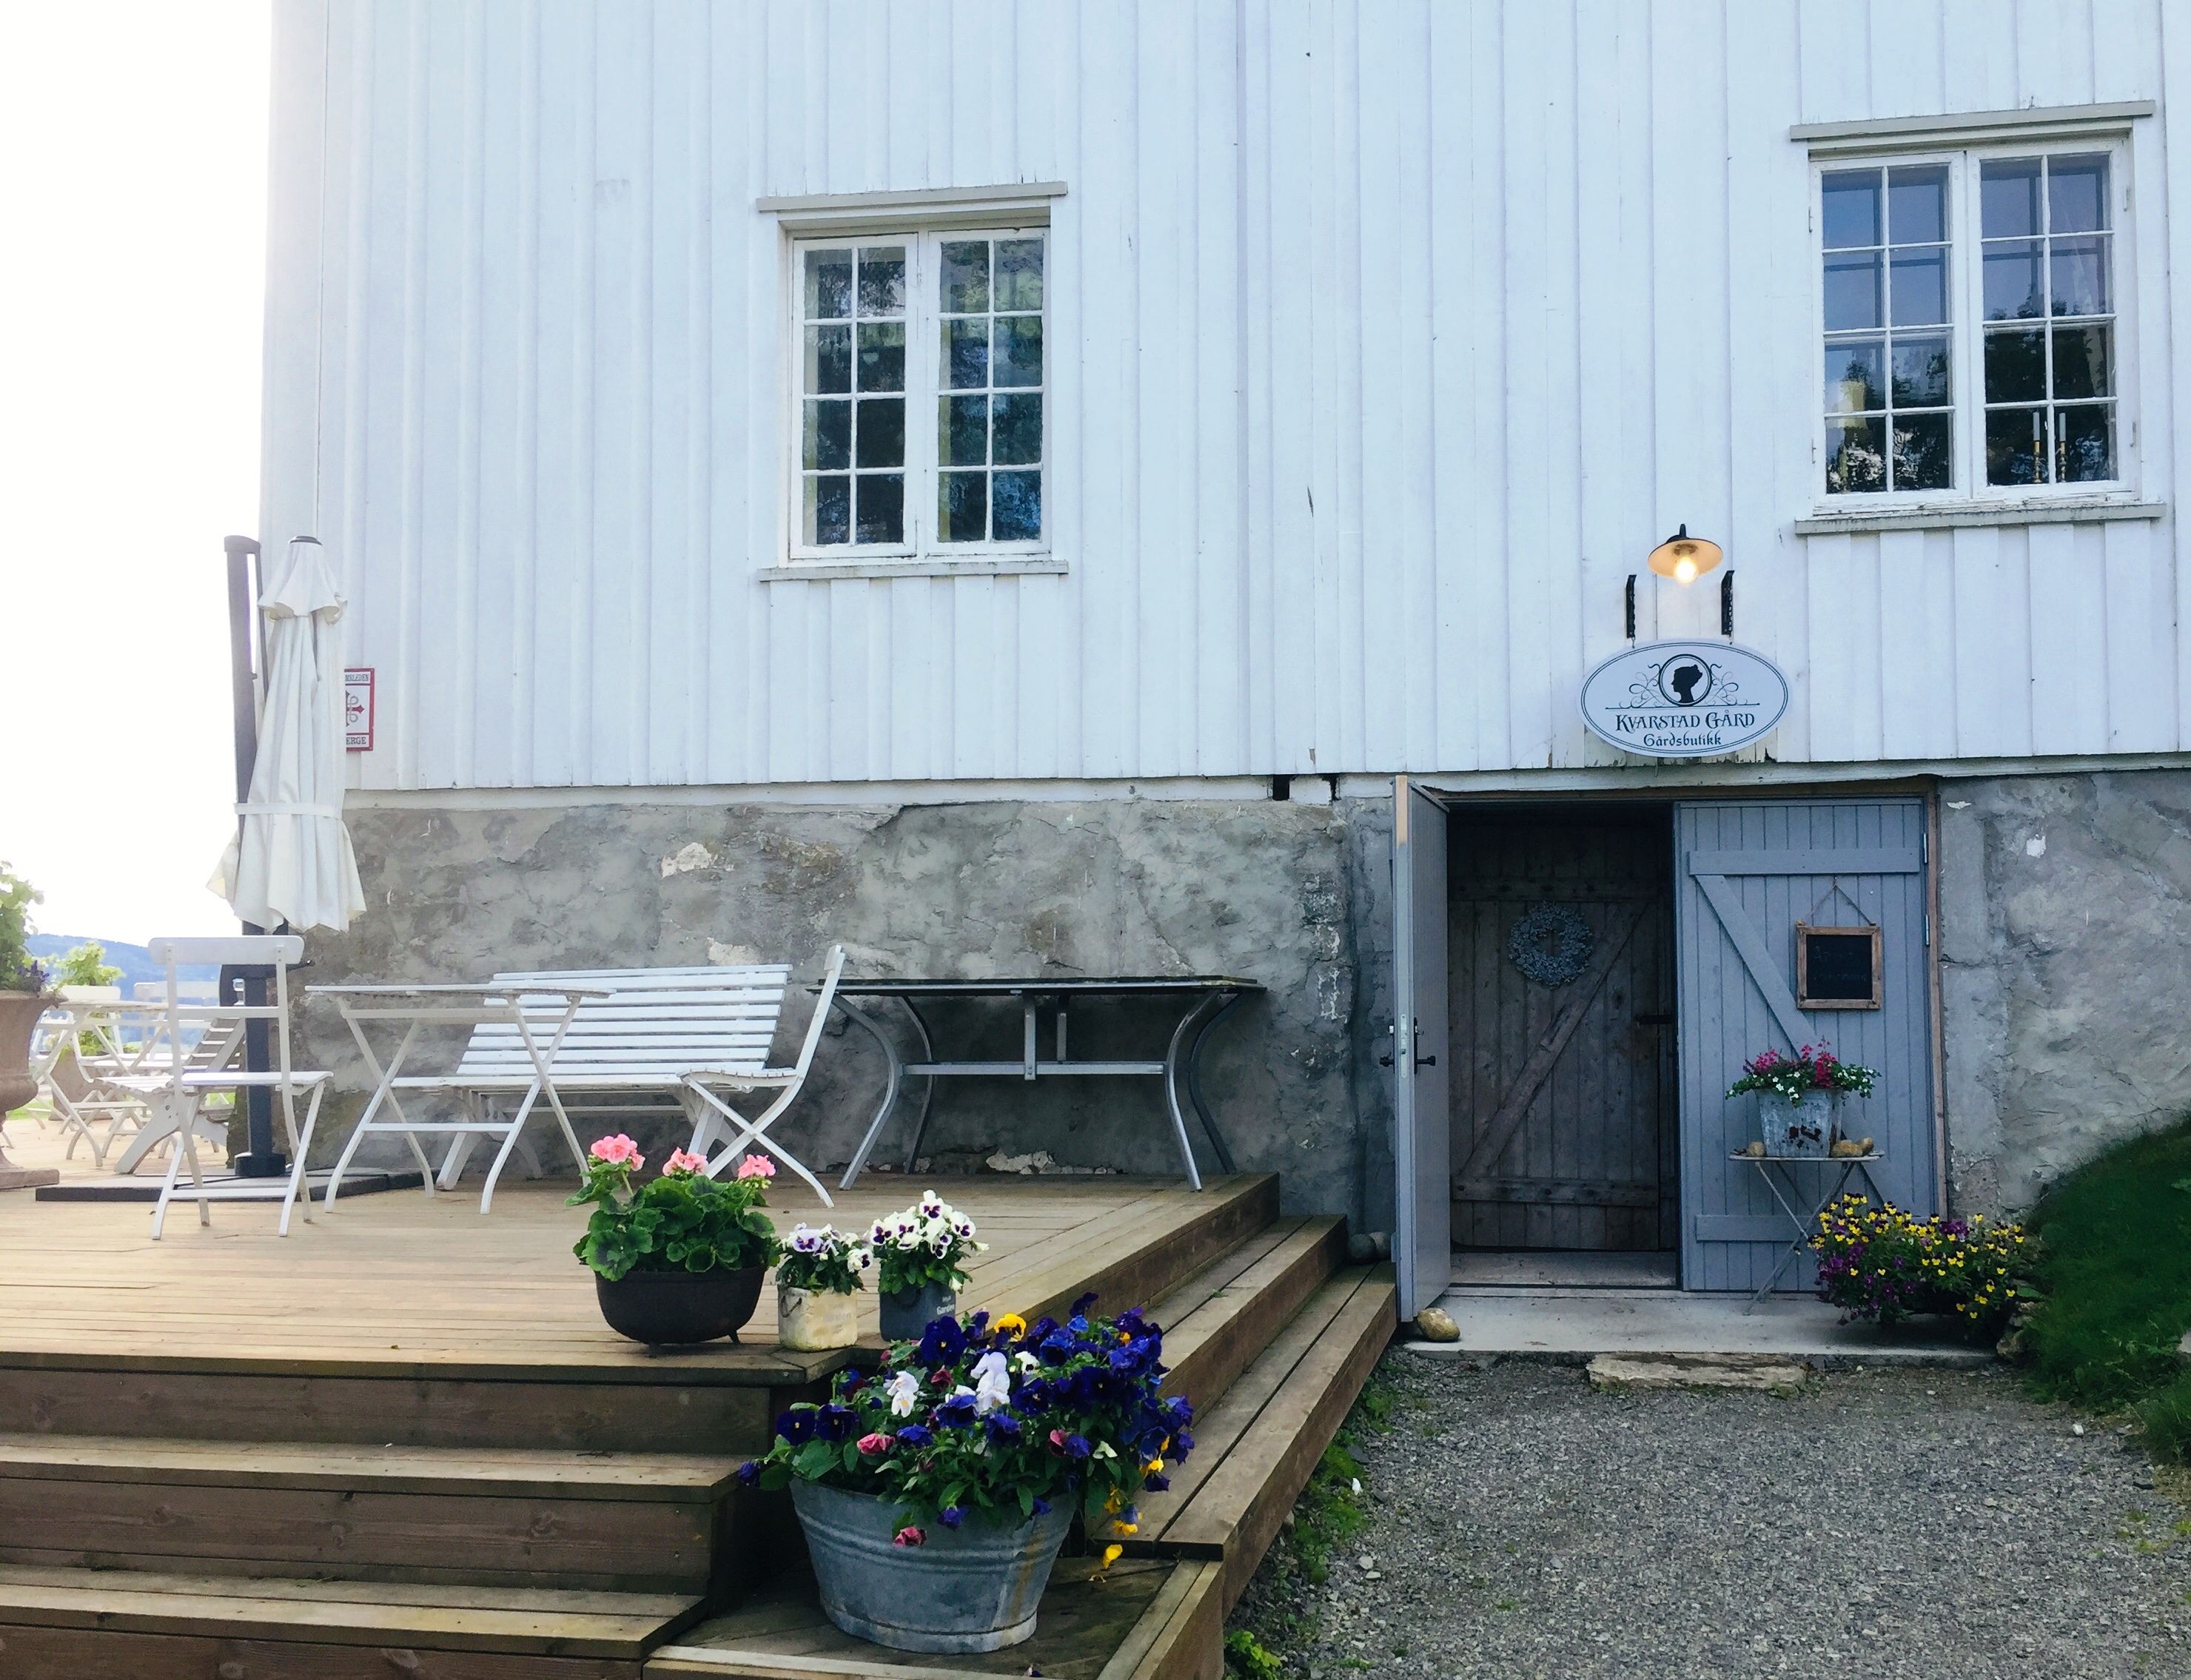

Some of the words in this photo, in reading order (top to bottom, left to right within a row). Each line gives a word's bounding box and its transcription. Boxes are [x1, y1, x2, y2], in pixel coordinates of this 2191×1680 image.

[1616, 713, 1700, 734] KVARSTAD
[1705, 709, 1755, 729] GÅRD
[346, 736, 366, 745] ERGE
[1643, 730, 1722, 747] Gårdsbutikk
